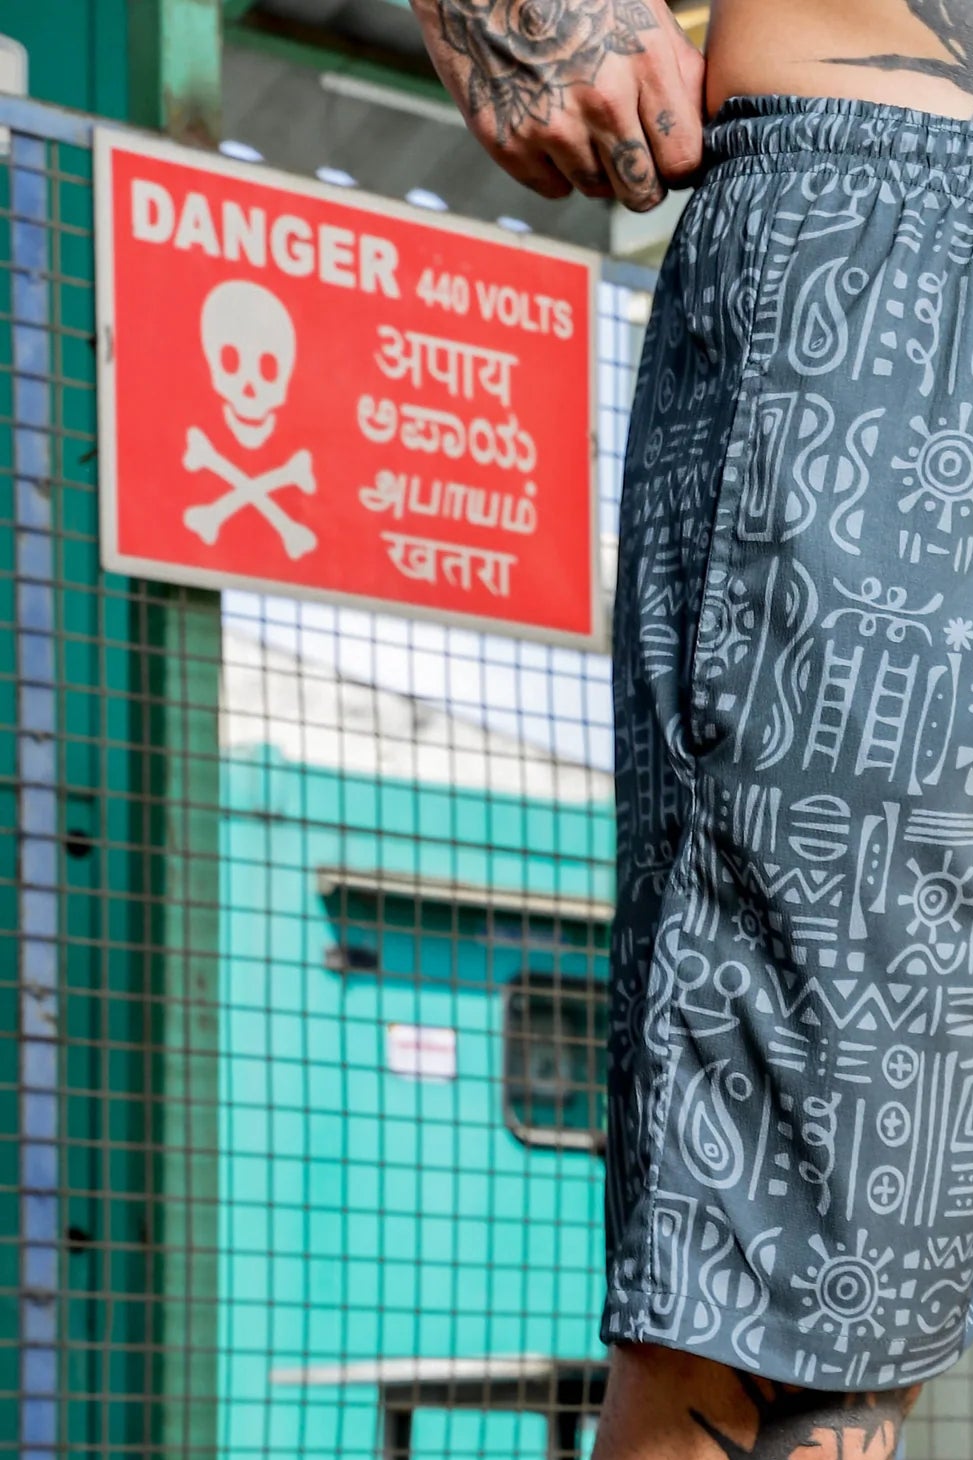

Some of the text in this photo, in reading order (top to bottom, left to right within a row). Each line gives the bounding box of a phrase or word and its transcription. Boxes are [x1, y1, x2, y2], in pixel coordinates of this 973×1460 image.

[131, 178, 574, 340] DANGER 440 VOLTS
[373, 324, 519, 408] अपाय
[357, 394, 537, 473] ಅಪಾಯ
[359, 469, 537, 535] அபாயம்
[380, 530, 518, 597] खतरा
